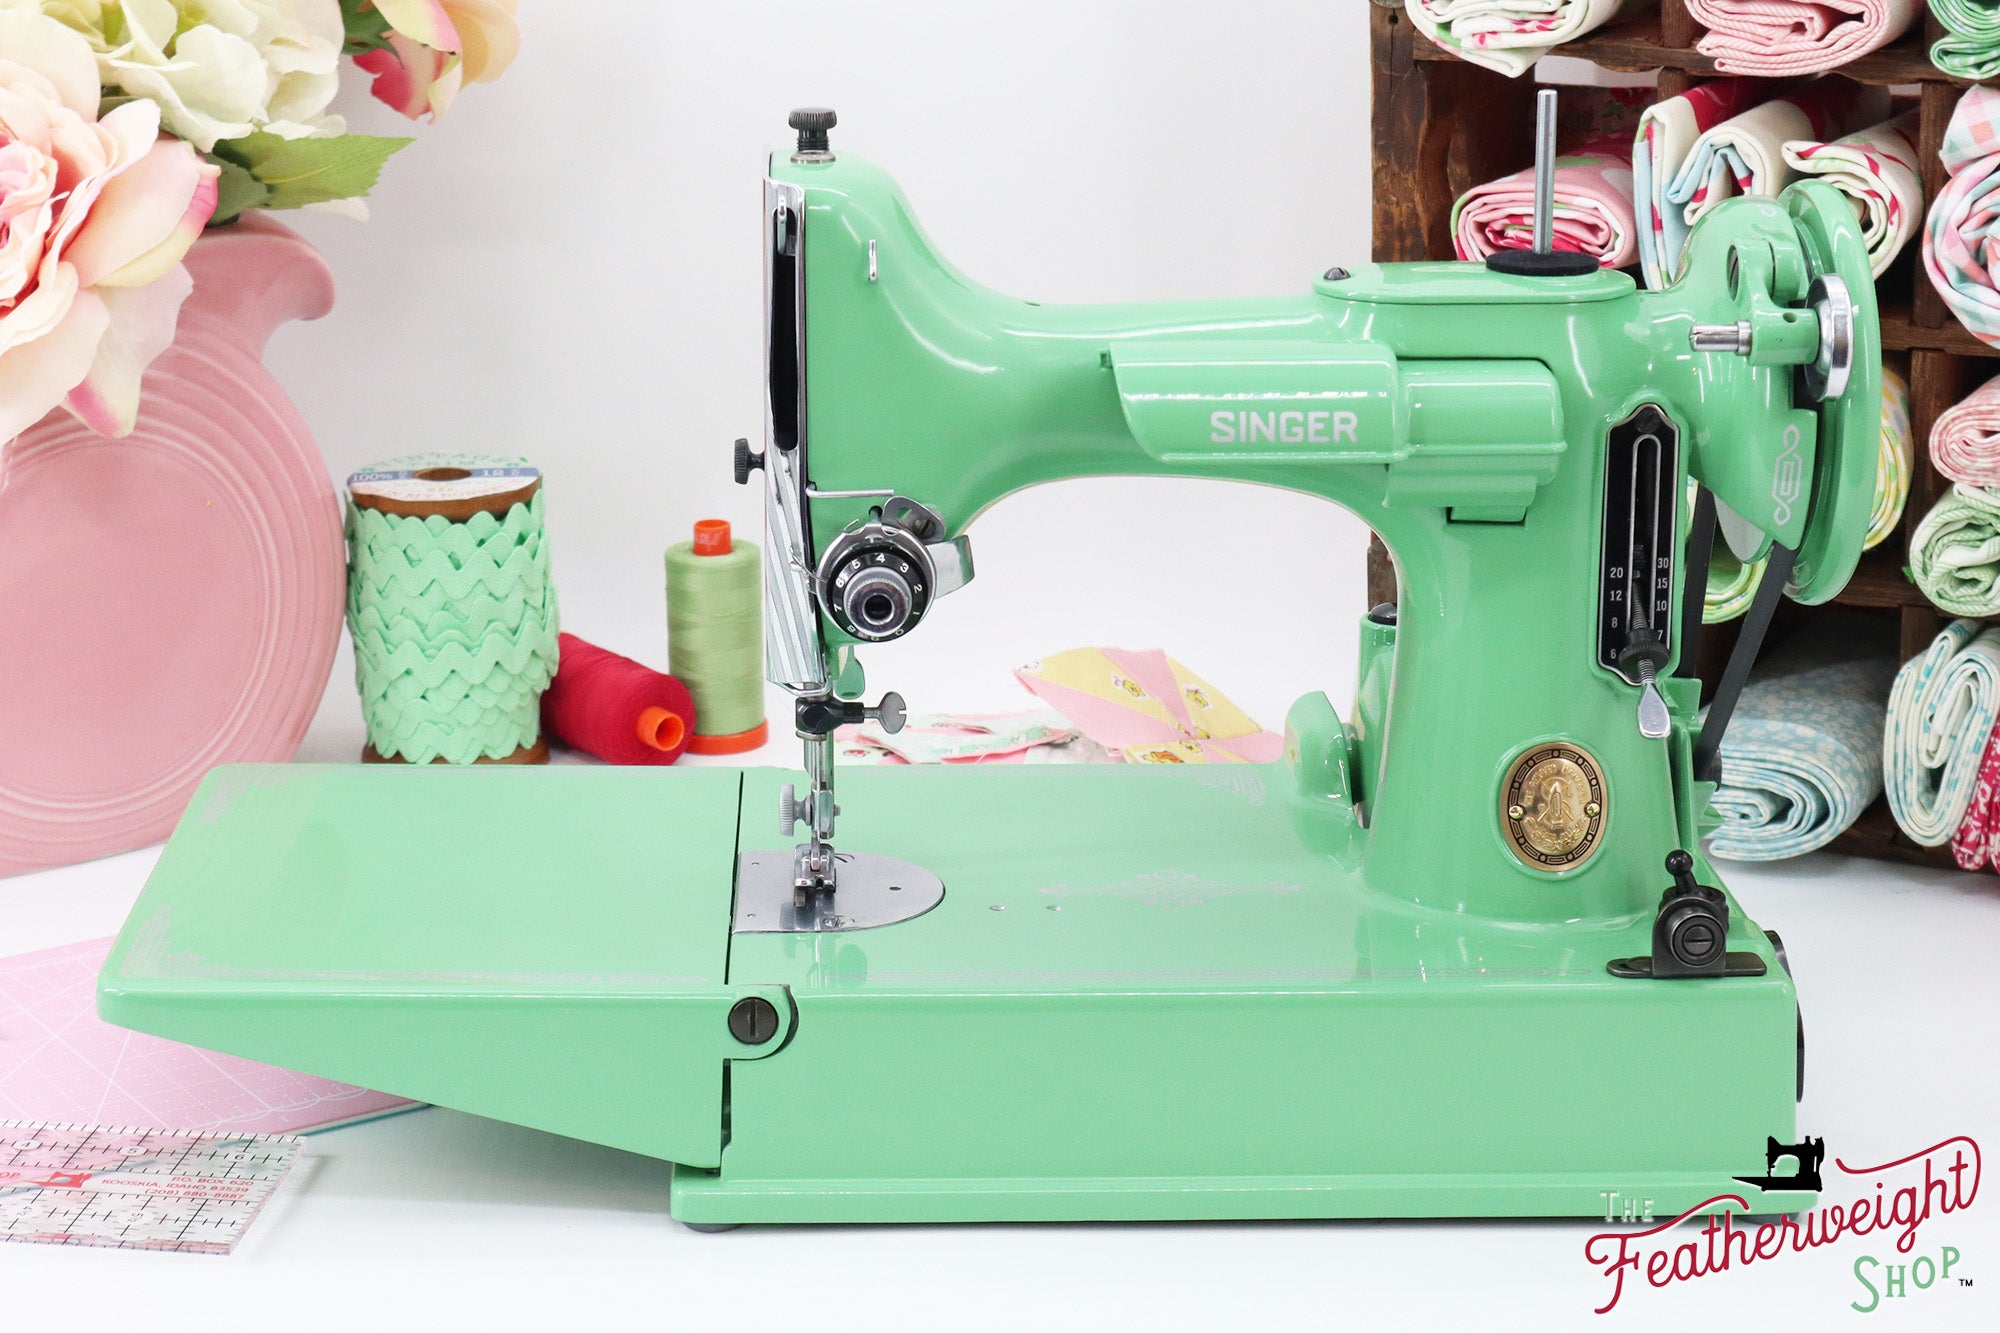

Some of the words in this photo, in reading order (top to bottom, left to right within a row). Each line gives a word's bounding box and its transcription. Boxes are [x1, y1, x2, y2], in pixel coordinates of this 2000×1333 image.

[1210, 411, 1359, 444] SINGER
[835, 578, 844, 588] 6
[851, 559, 861, 570] 5
[876, 553, 886, 564] 4
[900, 563, 909, 574] 3
[913, 583, 923, 594] 2
[1610, 567, 1624, 578] 20
[1657, 558, 1669, 569] 30
[1610, 590, 1623, 601] 12
[1657, 578, 1668, 589] 15
[833, 603, 843, 613] 7
[1656, 601, 1668, 612] 10
[1611, 617, 1619, 628] 8
[1657, 630, 1664, 641] 7
[1610, 649, 1617, 660] 6
